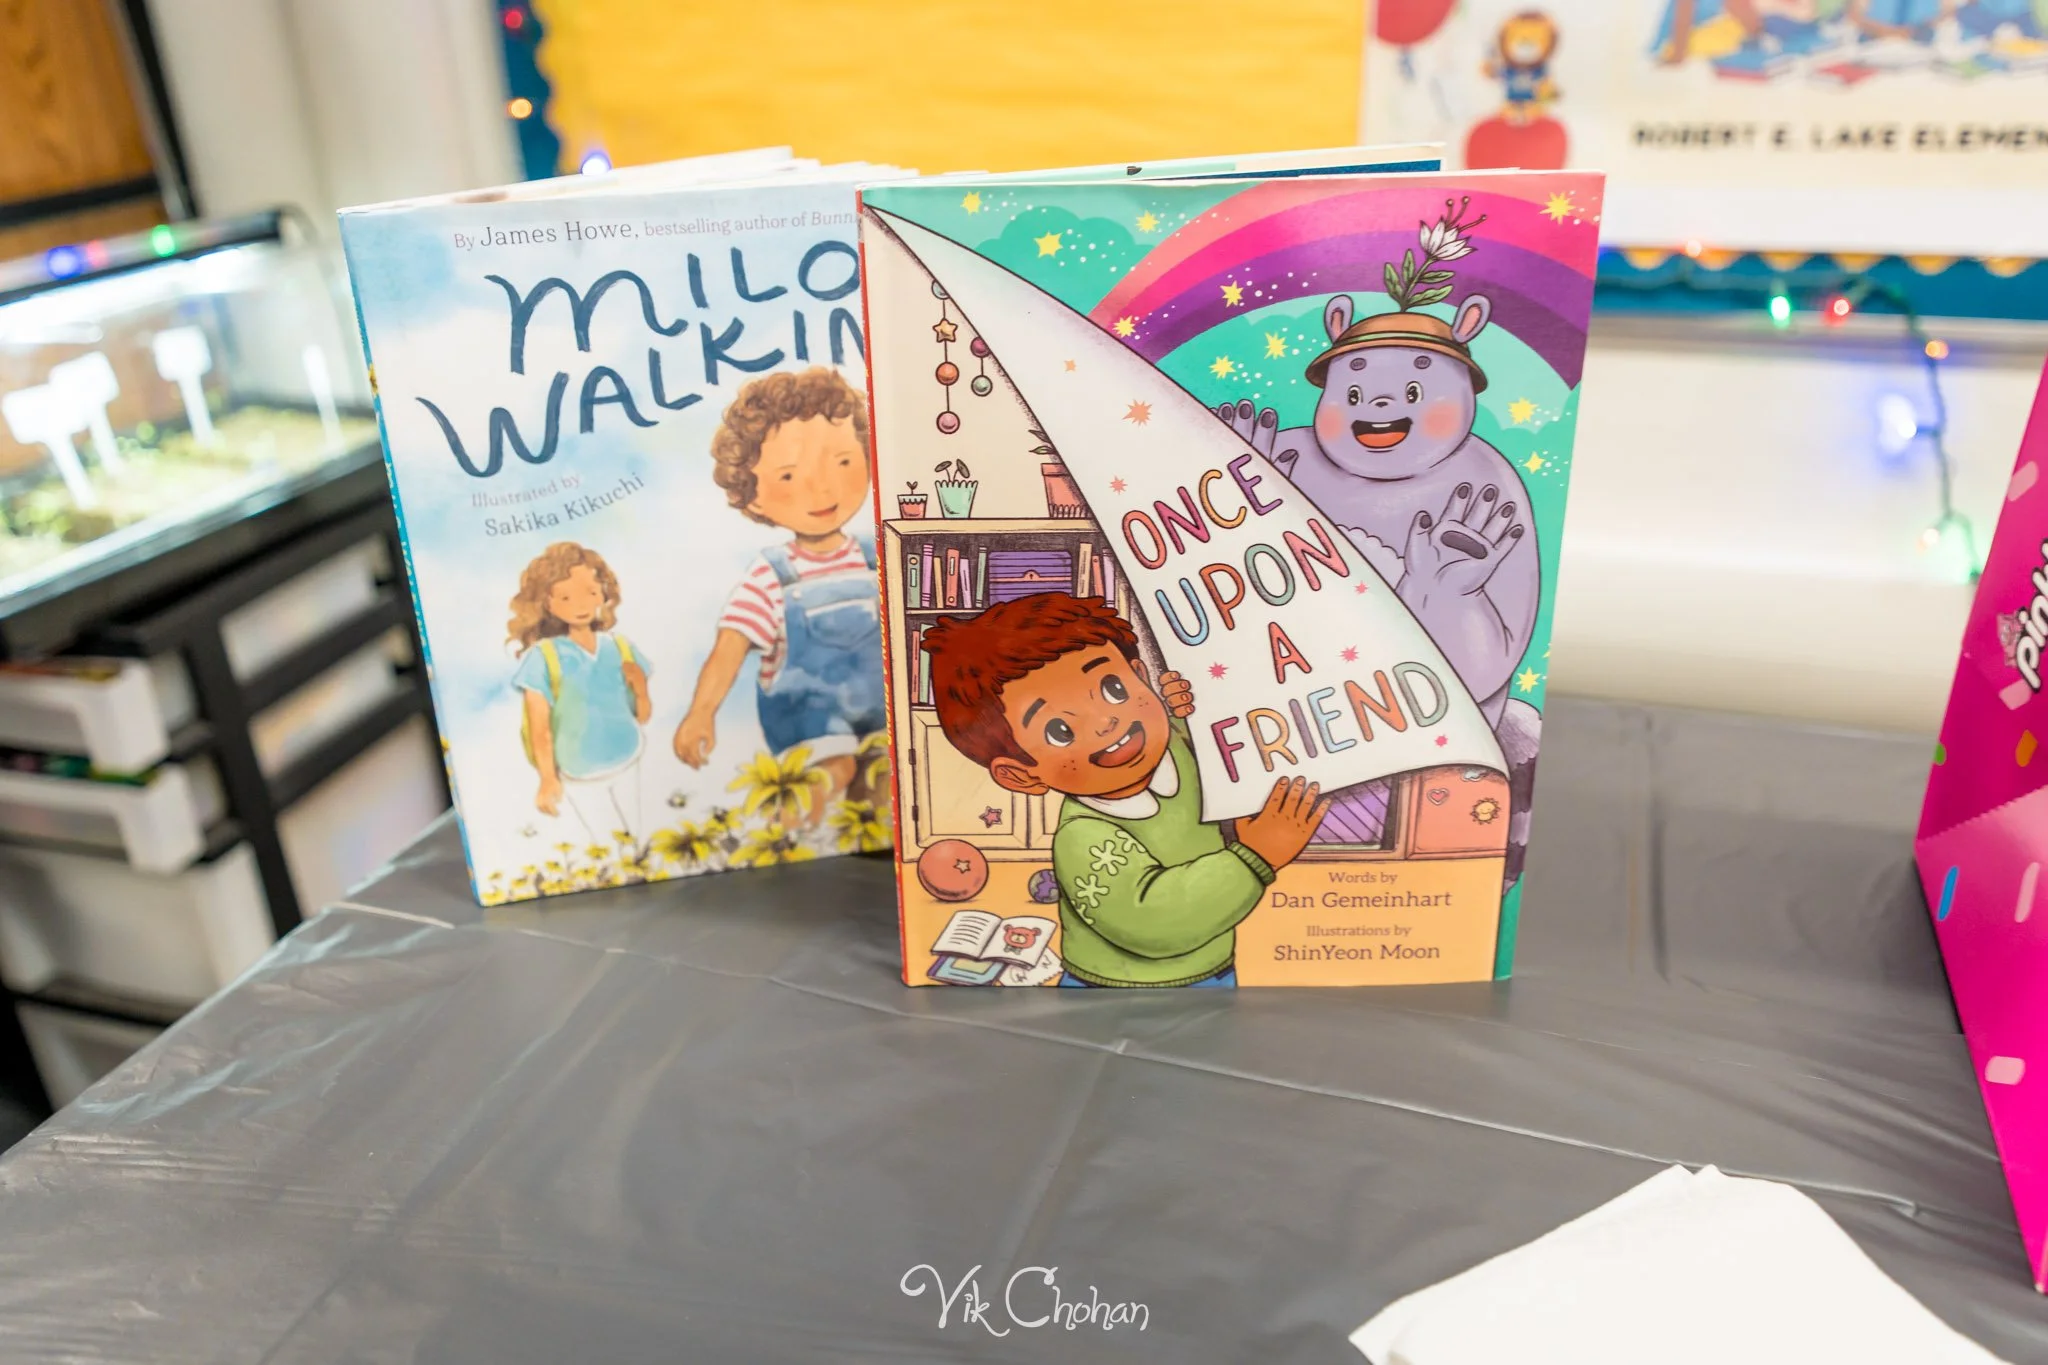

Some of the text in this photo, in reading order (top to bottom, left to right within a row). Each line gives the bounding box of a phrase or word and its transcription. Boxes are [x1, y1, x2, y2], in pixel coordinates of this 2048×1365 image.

[1633, 122, 1757, 150] ROBERT
[1811, 122, 1900, 150] LAKE
[454, 210, 858, 251] By James Howe, bestselling author of Bunn
[484, 240, 860, 374] MILO
[472, 475, 581, 508] Illustrated by
[484, 472, 645, 537] Sakika Kikuchi
[1122, 453, 1284, 570] ONCE
[1155, 518, 1350, 647] UPON
[1268, 621, 1312, 684] A
[1210, 661, 1449, 783] FRIEND
[1328, 871, 1398, 885] Words by
[1271, 890, 1453, 908] Dan Gemeinhart
[1273, 943, 1440, 961] ShinYeon Moon
[1306, 925, 1412, 938] Illustrations by
